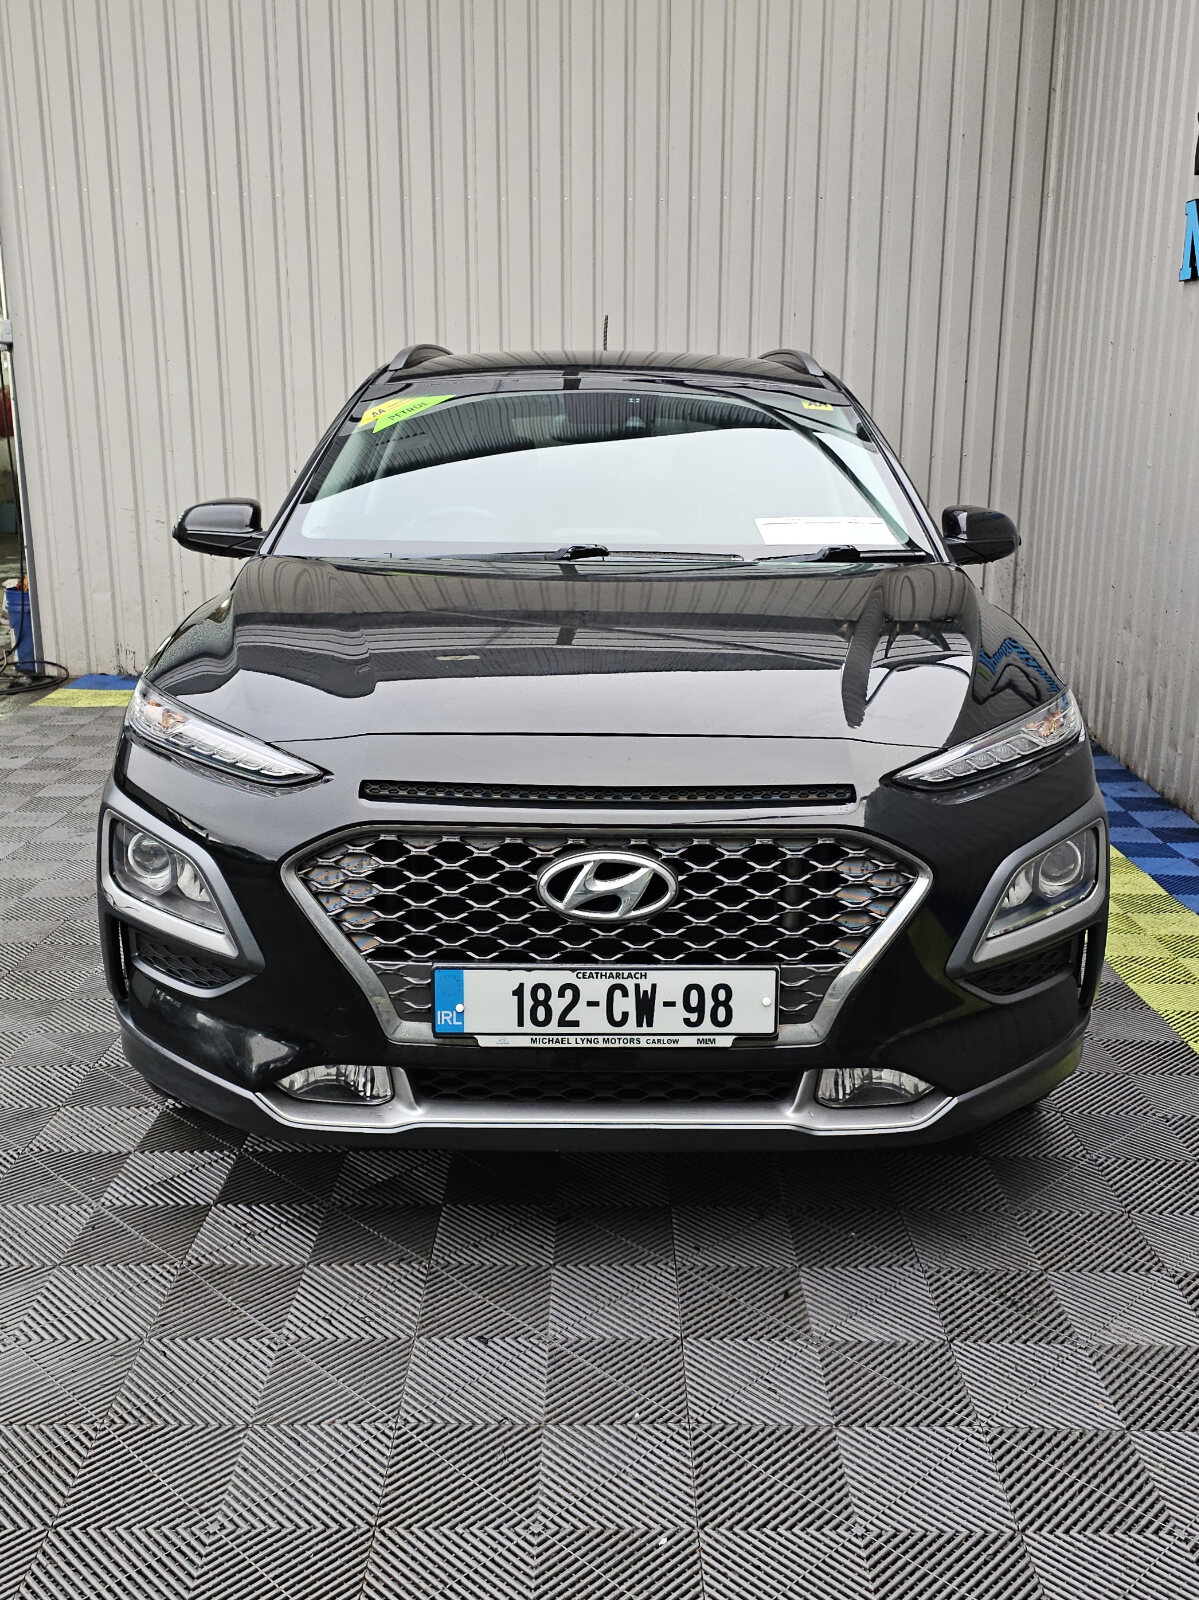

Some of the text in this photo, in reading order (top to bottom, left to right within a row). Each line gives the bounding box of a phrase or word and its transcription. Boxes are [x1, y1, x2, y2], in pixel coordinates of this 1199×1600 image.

[388, 402, 429, 420] PETROL
[575, 971, 648, 980] CEATHARLACH
[511, 982, 733, 1028] 182-CW-98
[437, 1010, 463, 1025] IRL
[530, 1037, 572, 1045] MICHAEL
[574, 1037, 600, 1045] LYNG
[602, 1037, 641, 1045] MOTORS
[696, 1037, 716, 1045] MLM
